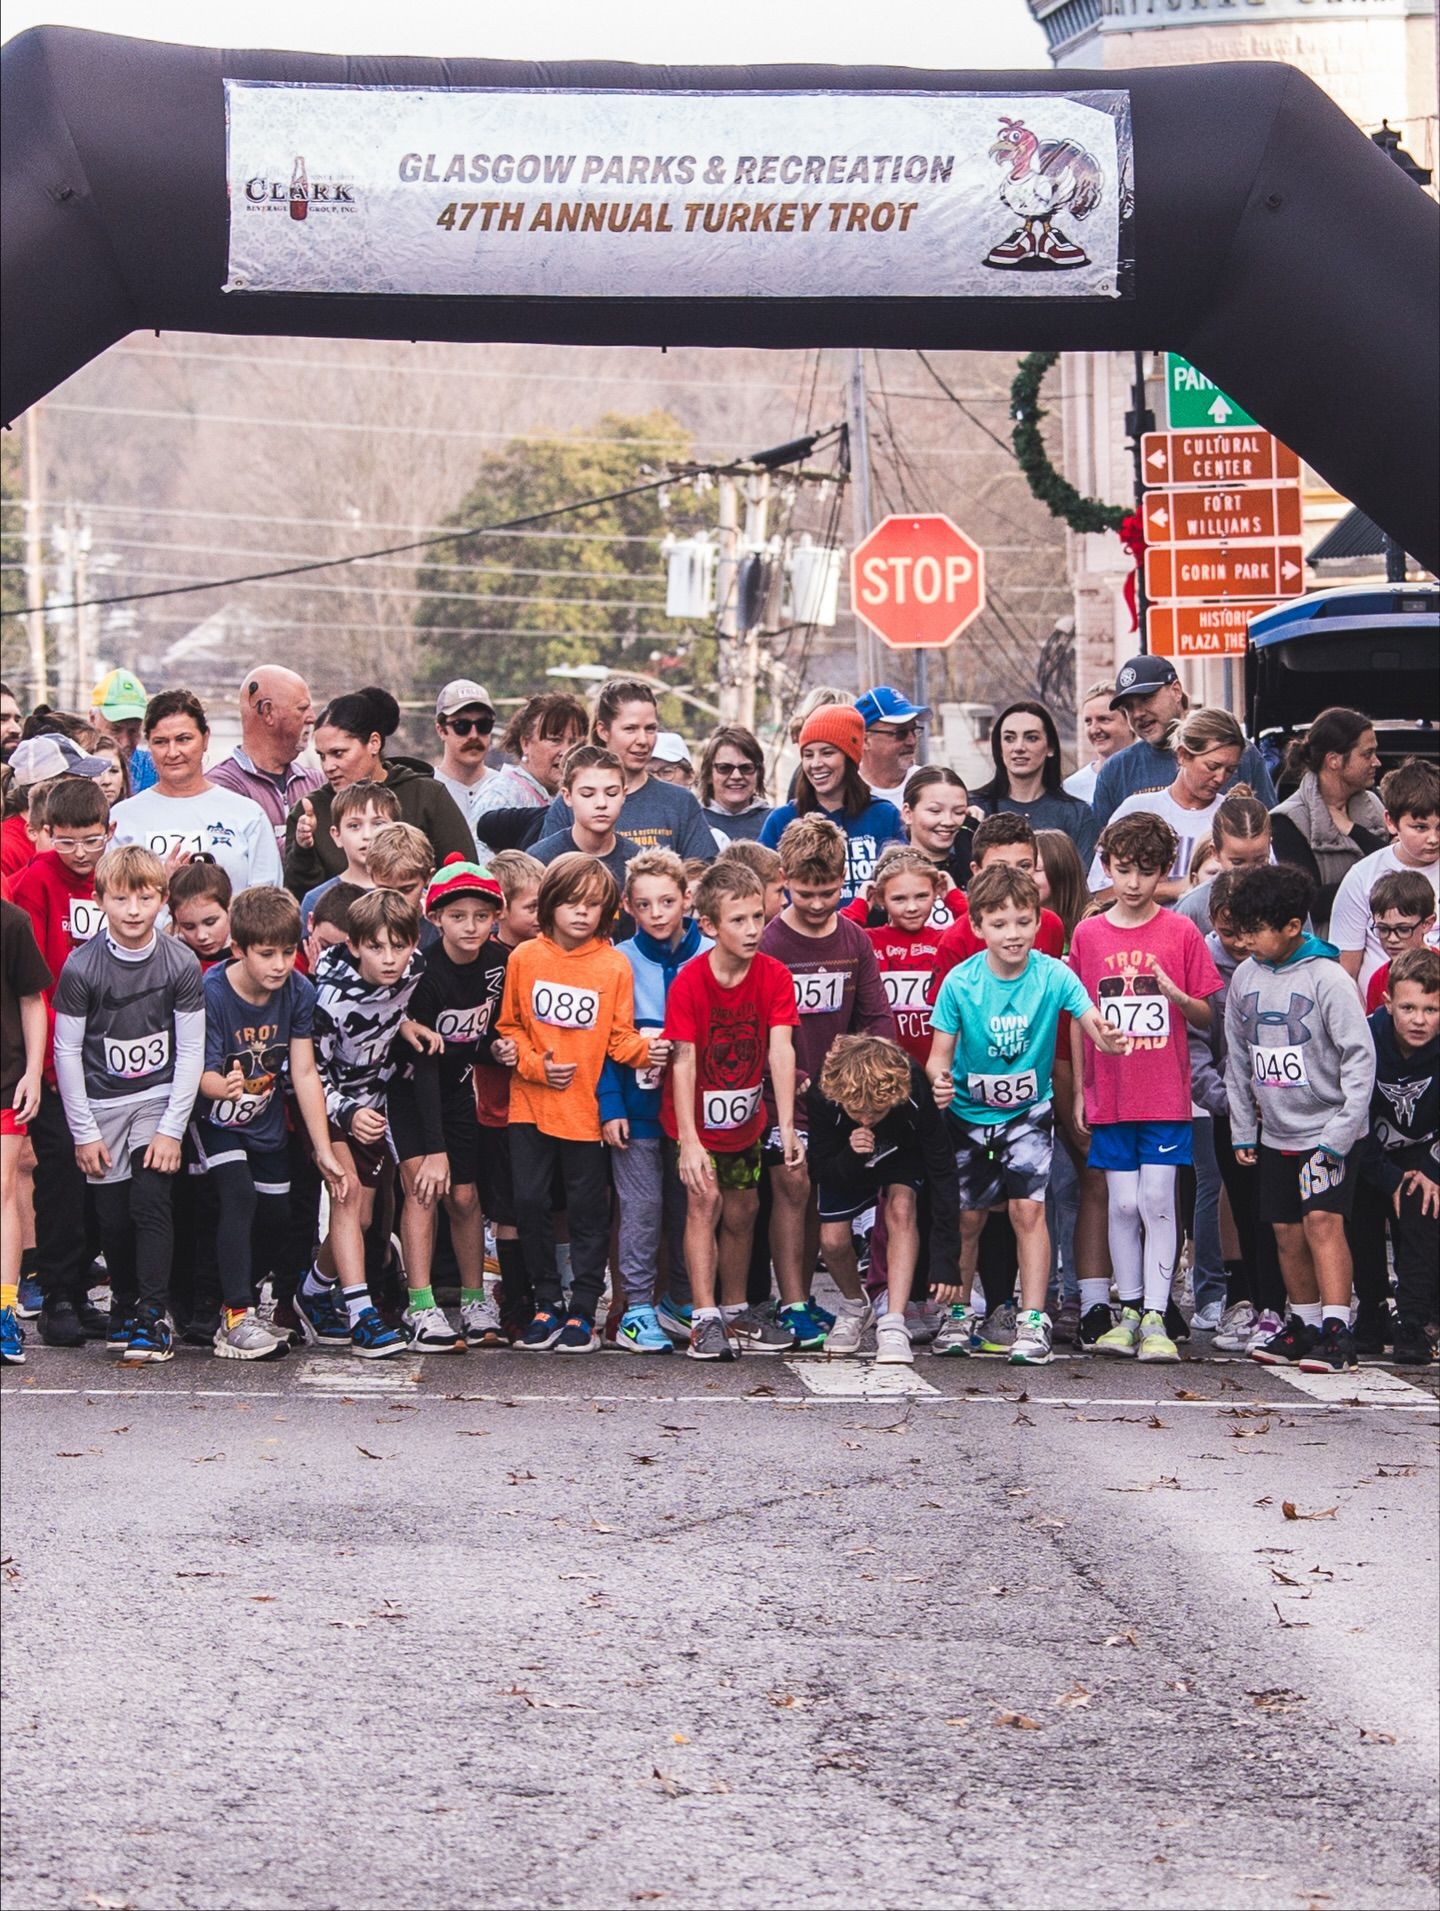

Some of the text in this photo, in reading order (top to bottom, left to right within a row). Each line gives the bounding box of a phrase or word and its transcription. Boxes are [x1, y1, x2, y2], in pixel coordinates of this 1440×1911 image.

[399, 152, 955, 185] GLASGOW PARKS & RECREATION
[245, 177, 355, 204] CLARK
[246, 205, 288, 213] BEVERAGE
[437, 202, 918, 232] 47TH ANNUAL TURKEY TROT
[1174, 366, 1219, 391] PAR
[1183, 437, 1260, 456] CULTURAL
[1193, 460, 1253, 477] CENTER
[1204, 495, 1242, 512] FORT
[1187, 517, 1262, 535] WILLIAMS
[862, 556, 973, 605] STOP
[1181, 563, 1270, 581] GORIN PARK
[1181, 633, 1246, 650] PLAZA THE
[74, 906, 107, 935] 07
[1104, 950, 1156, 971] TROT
[535, 988, 595, 1025] 088
[1105, 1002, 1164, 1031] 073
[438, 1008, 489, 1037] 049
[897, 1012, 931, 1037] PCE
[990, 1015, 1029, 1033] OWN
[988, 1040, 1030, 1057] GAME
[994, 1028, 1025, 1047] THE
[109, 1039, 165, 1072] 093
[1256, 1052, 1302, 1081] 046
[974, 1075, 1034, 1104] 185
[216, 1100, 258, 1123] 08
[708, 1087, 762, 1124] 067
